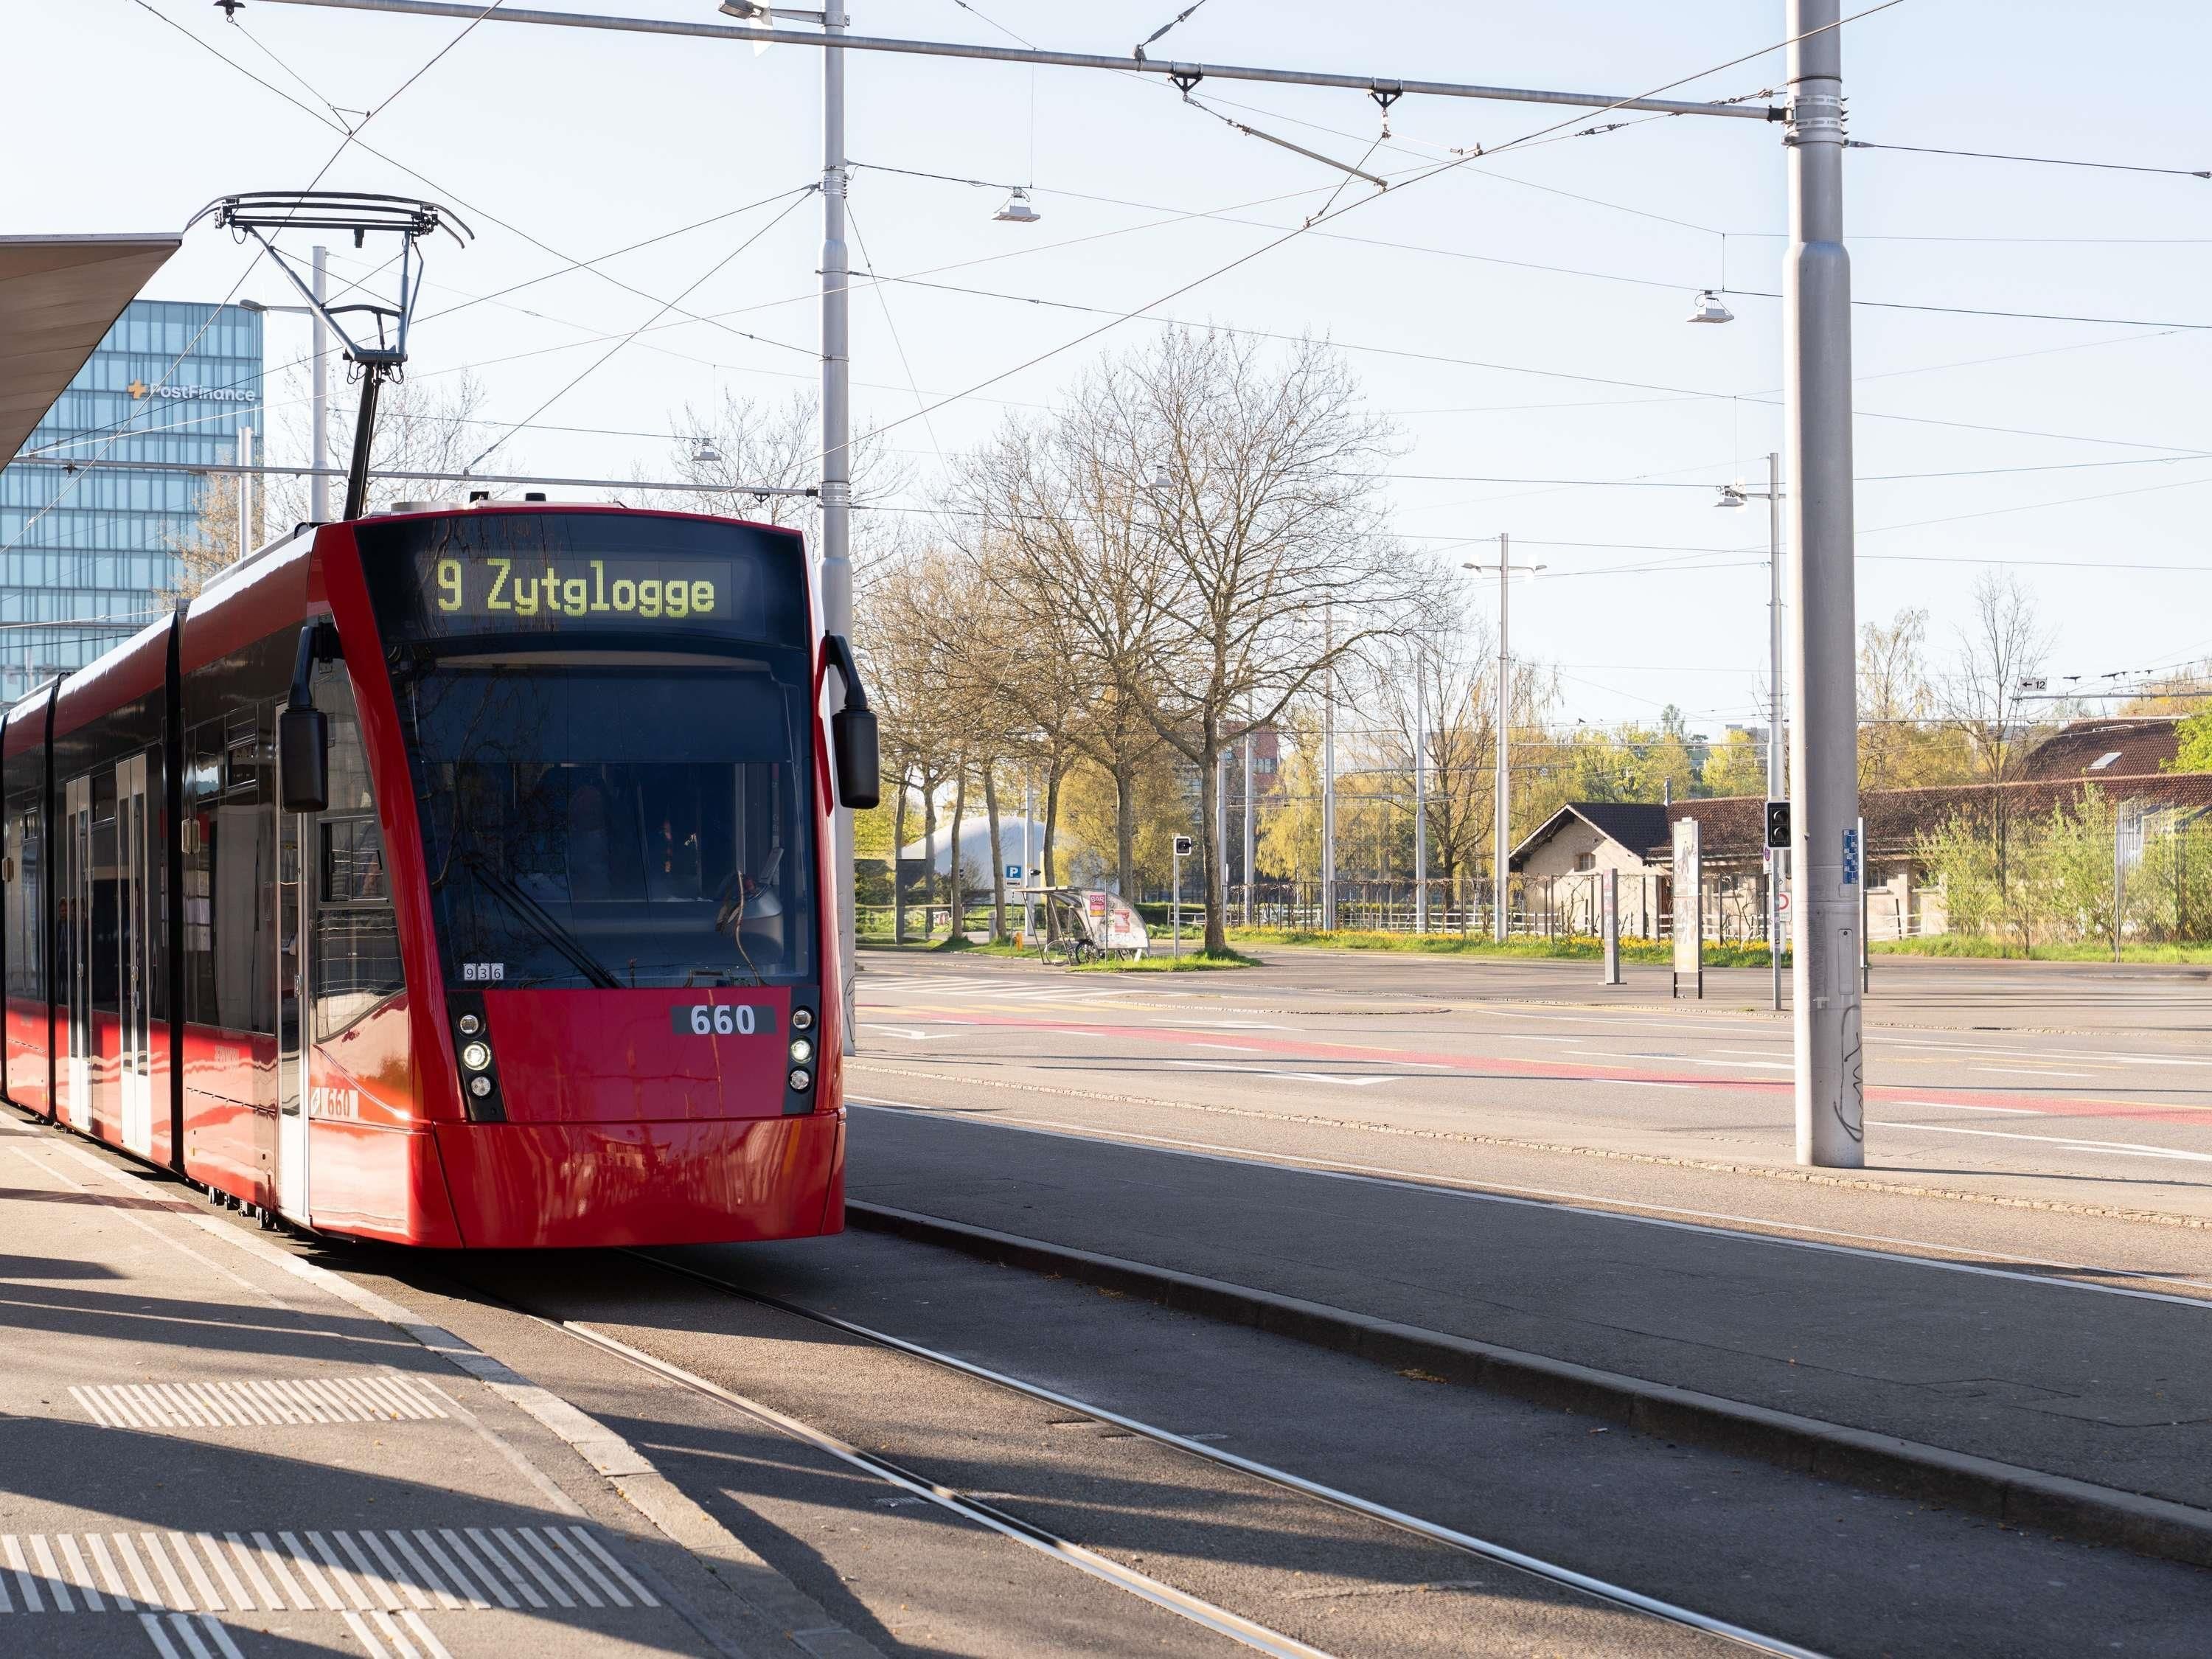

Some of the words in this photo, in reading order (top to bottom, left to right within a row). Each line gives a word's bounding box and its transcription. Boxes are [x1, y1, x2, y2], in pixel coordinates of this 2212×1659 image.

[150, 383, 256, 402] PostFinance
[437, 558, 462, 611] 9
[487, 558, 714, 619] Zytglogge
[2035, 681, 2045, 689] 12
[1009, 866, 1019, 877] P
[465, 968, 501, 979] 936
[691, 1004, 755, 1034] 660
[327, 1088, 350, 1118] 660
